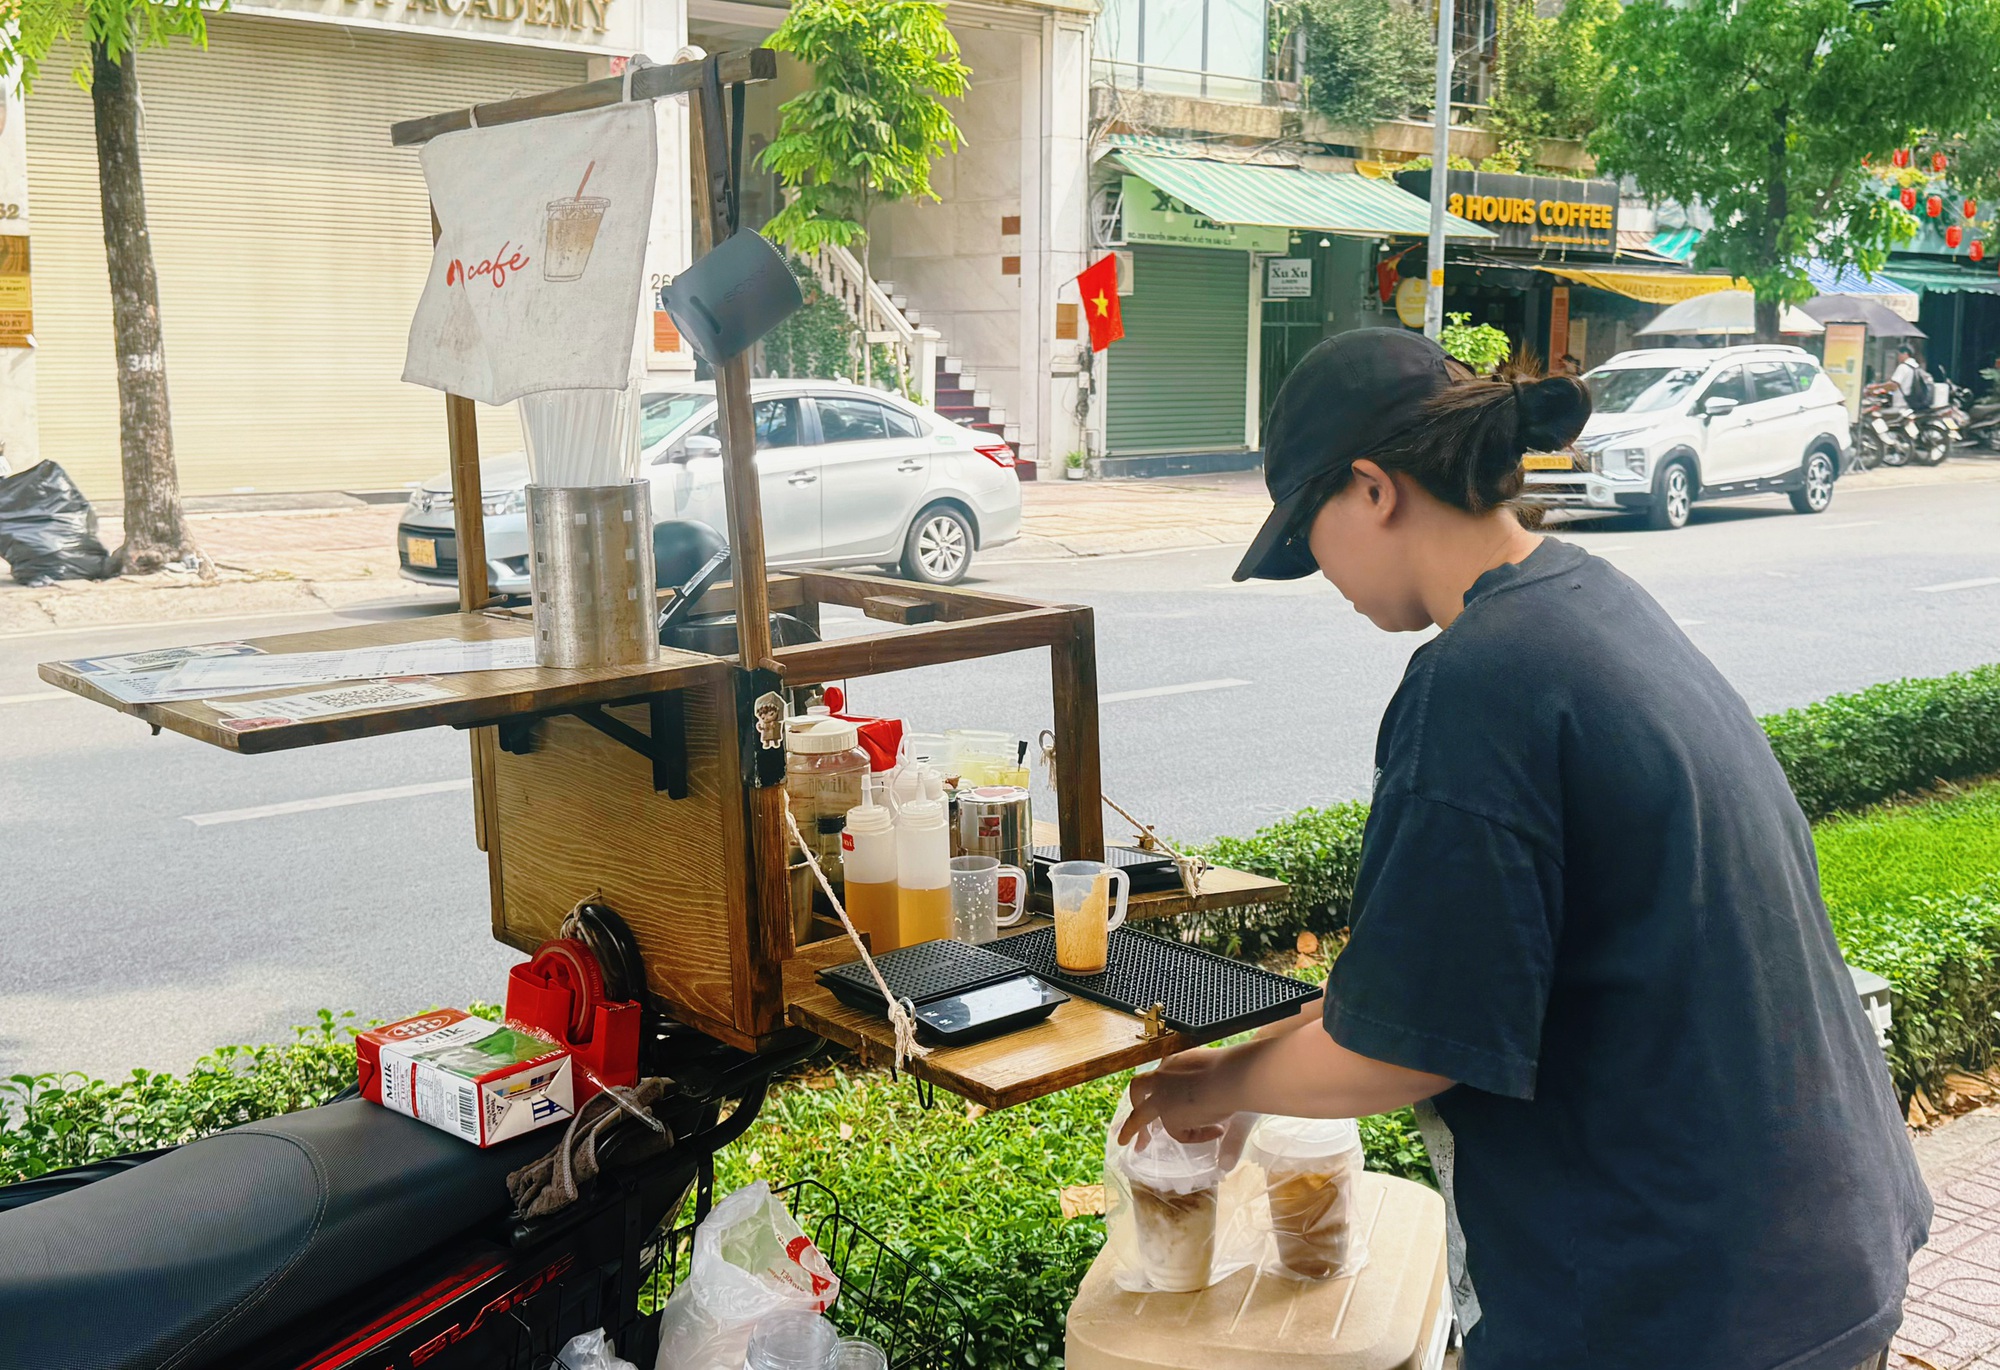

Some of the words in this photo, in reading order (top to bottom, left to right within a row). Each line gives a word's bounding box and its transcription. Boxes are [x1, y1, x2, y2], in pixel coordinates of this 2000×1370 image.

[1449, 193, 1464, 218] 8
[1465, 195, 1537, 225] HOURS
[1539, 200, 1614, 230] COFFEE
[414, 1027, 466, 1047] Milk
[384, 1062, 394, 1100] Milk
